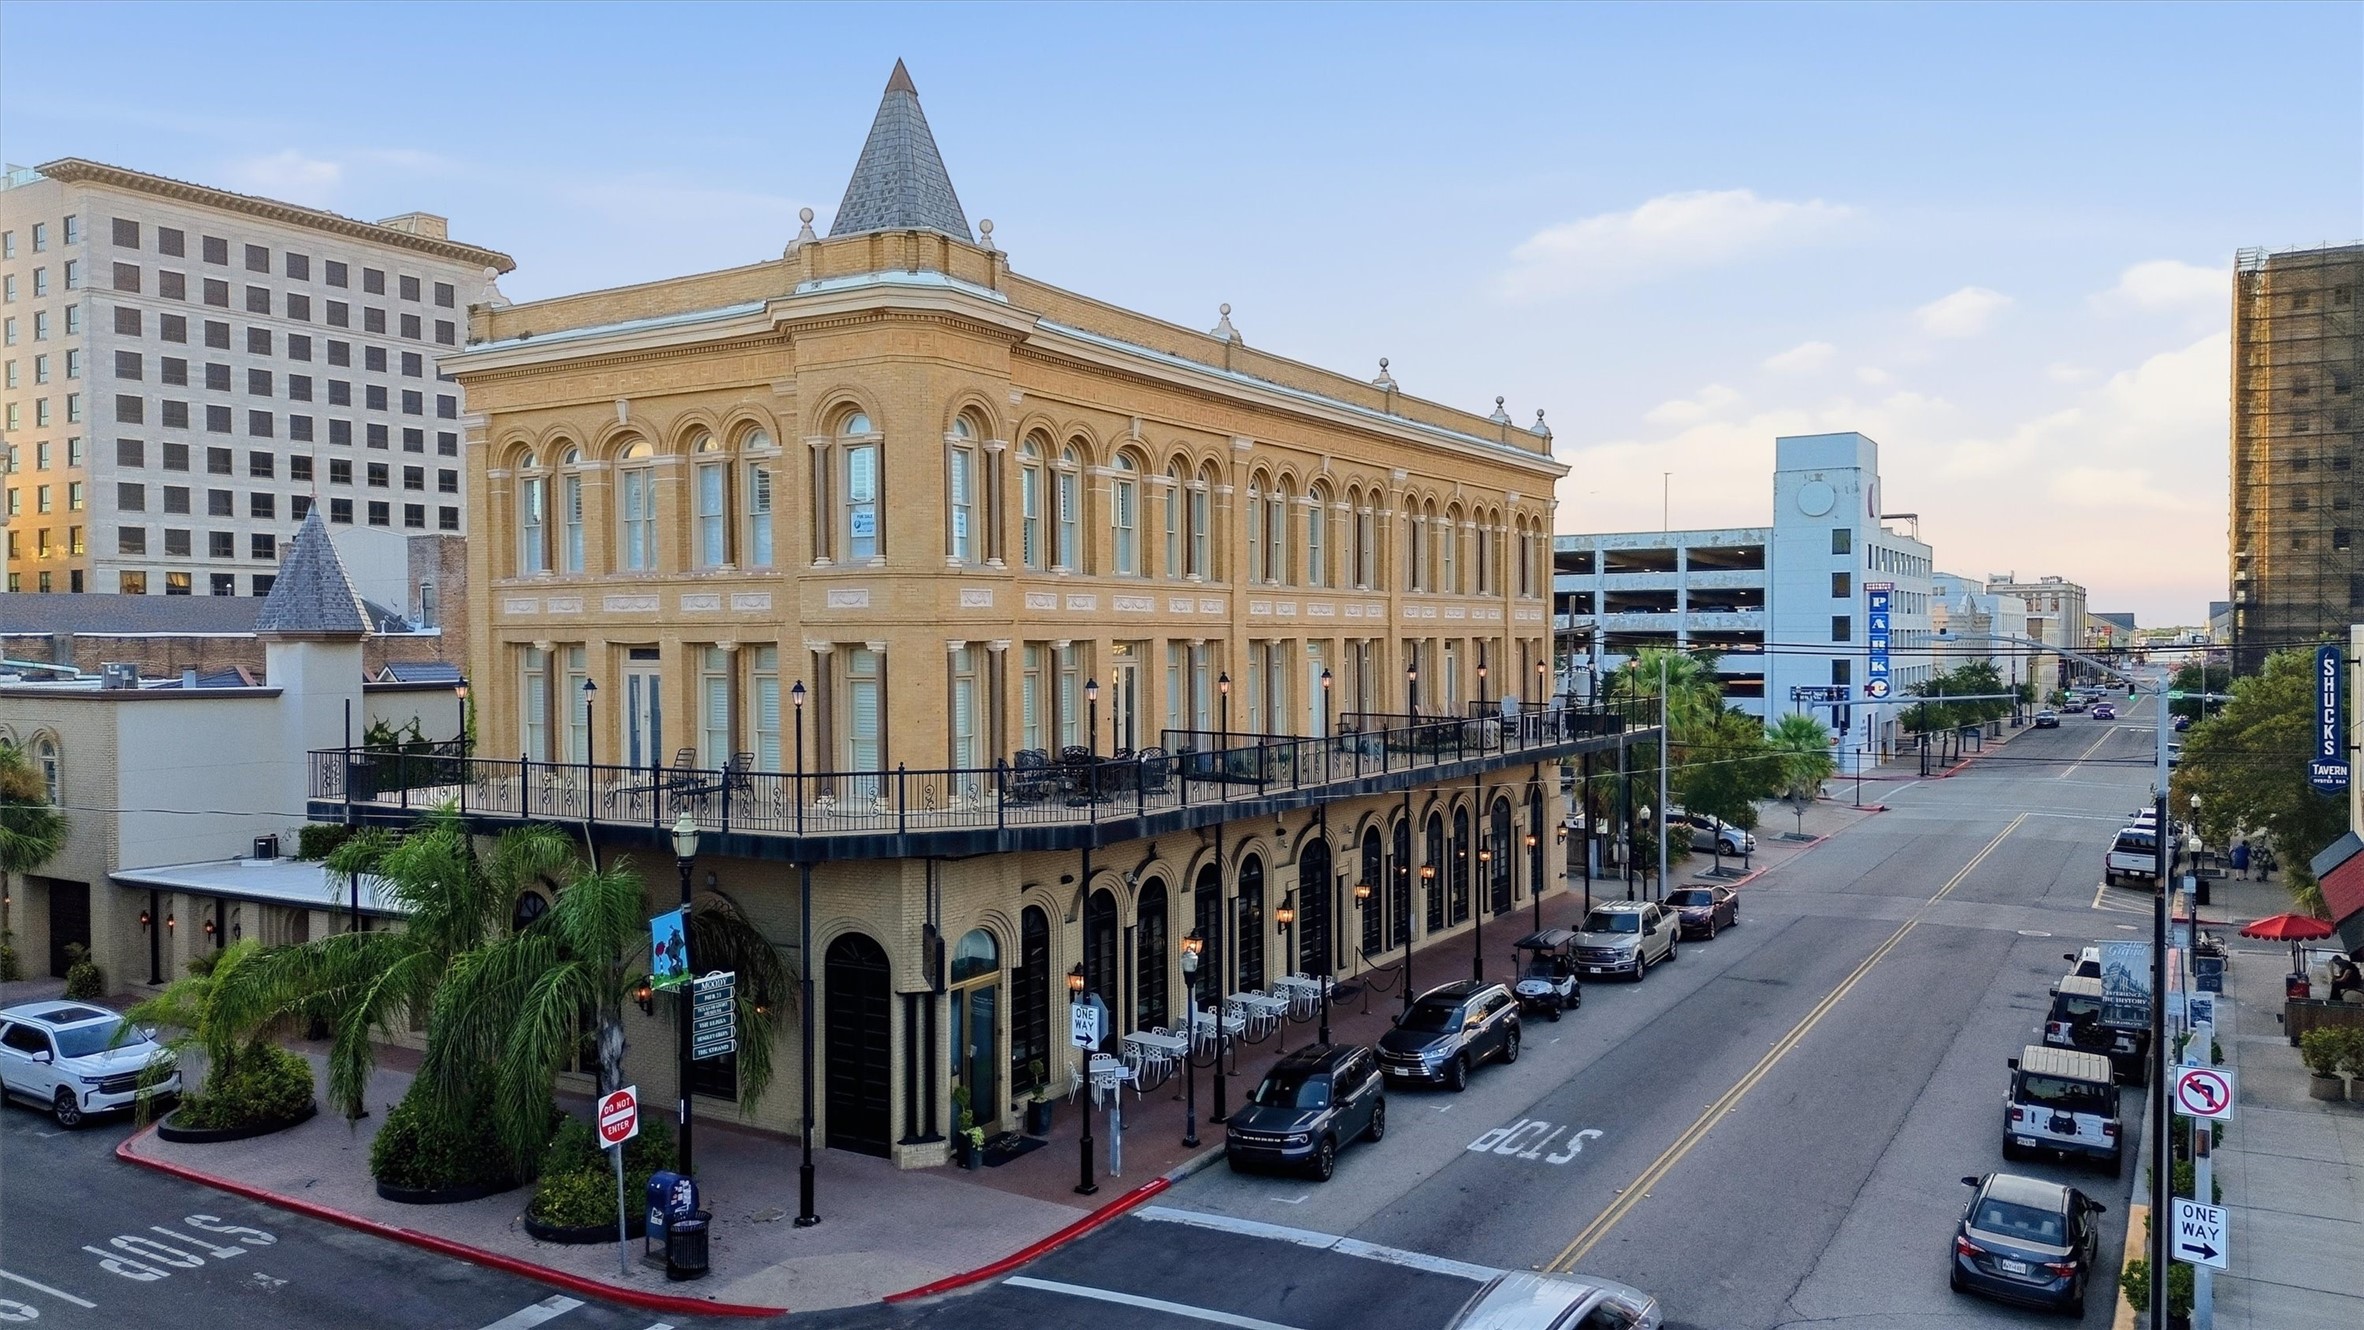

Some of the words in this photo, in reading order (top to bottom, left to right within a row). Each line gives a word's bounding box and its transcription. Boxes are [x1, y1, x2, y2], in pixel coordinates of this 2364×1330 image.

[1871, 597, 1887, 672] PARK
[2323, 659, 2335, 755] SHUCKS
[2312, 764, 2348, 776] TAVERN
[701, 977, 727, 991] MOODY
[2115, 997, 2148, 1005] HISTORY
[1076, 1008, 1094, 1020] ONE
[1075, 1020, 1094, 1031] WAY
[604, 1104, 614, 1115] DO
[616, 1097, 631, 1110] NOT
[607, 1120, 630, 1136] ENTER
[1466, 1118, 1604, 1165] STOP
[2182, 1204, 2218, 1224] ONE
[2182, 1221, 2220, 1241] WAY
[82, 1214, 278, 1281] STOP
